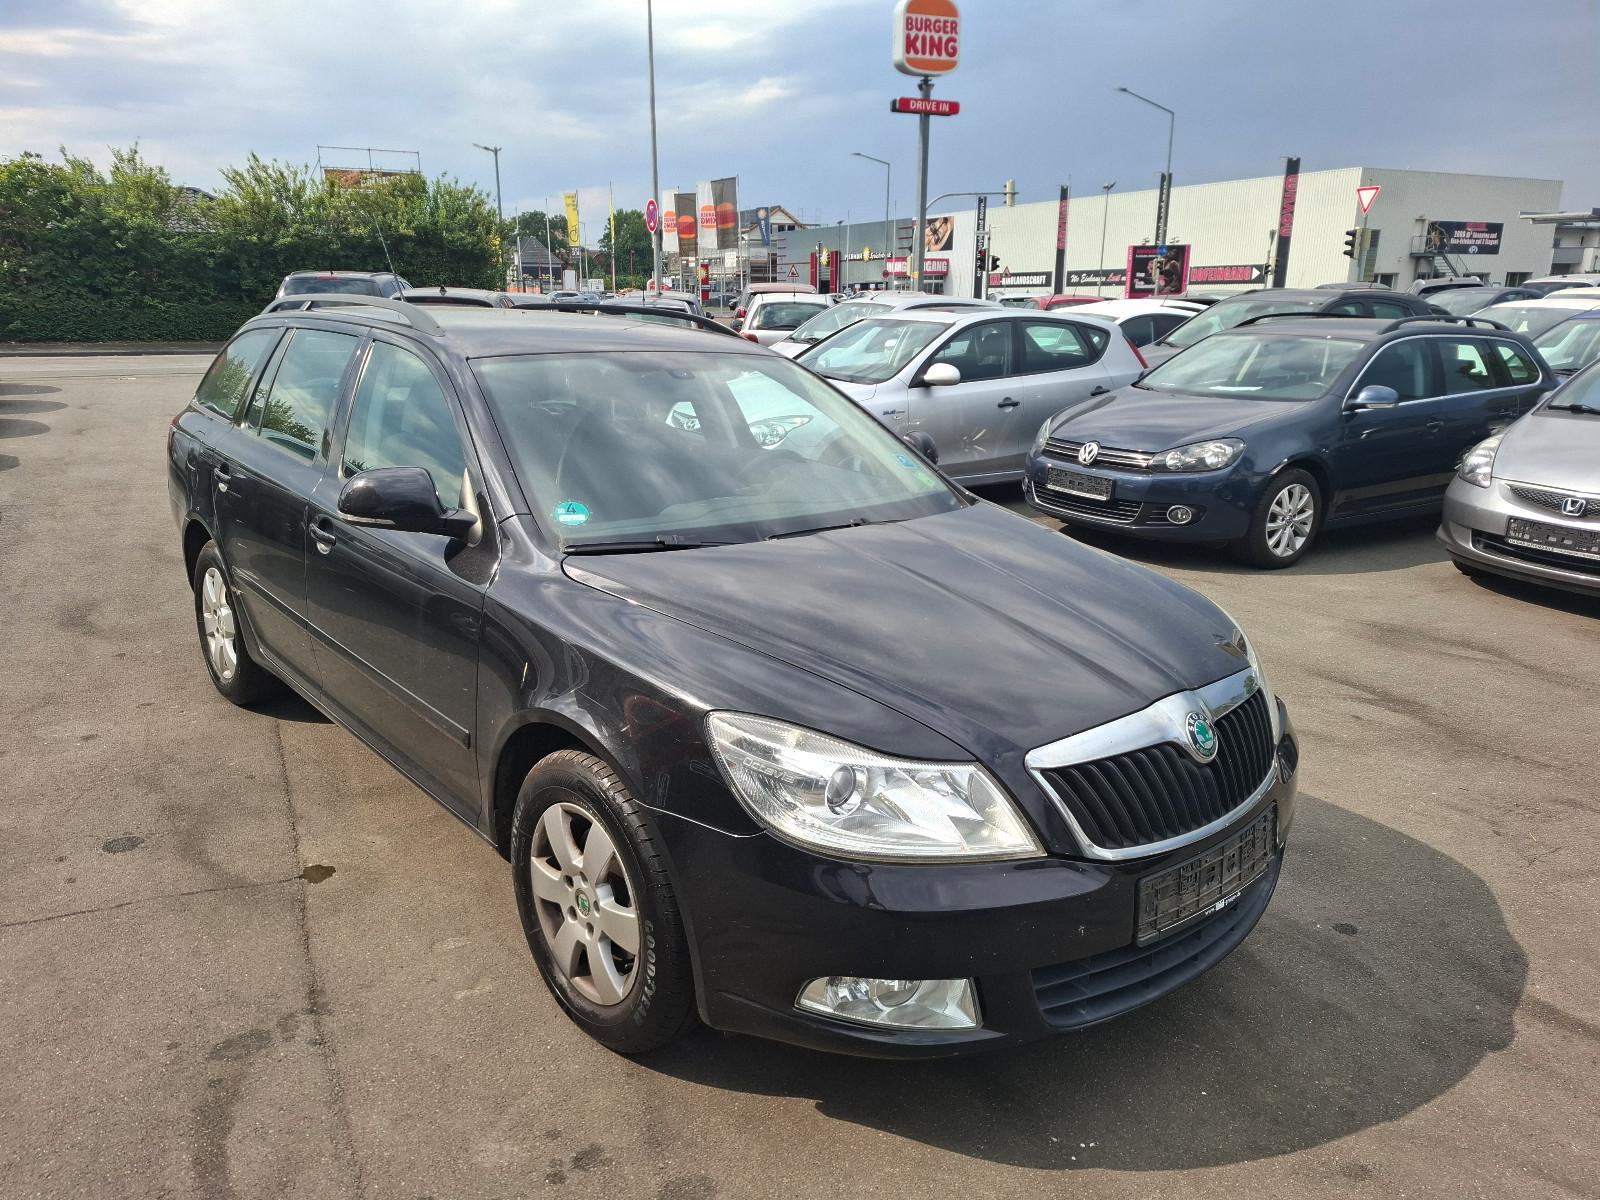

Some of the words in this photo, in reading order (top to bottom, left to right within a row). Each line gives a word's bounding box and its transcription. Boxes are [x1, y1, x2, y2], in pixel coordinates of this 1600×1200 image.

[905, 16, 958, 34] BURGER
[905, 33, 958, 57] KING
[910, 100, 936, 111] DRIVE
[939, 102, 949, 112] IN
[567, 503, 576, 513] 4
